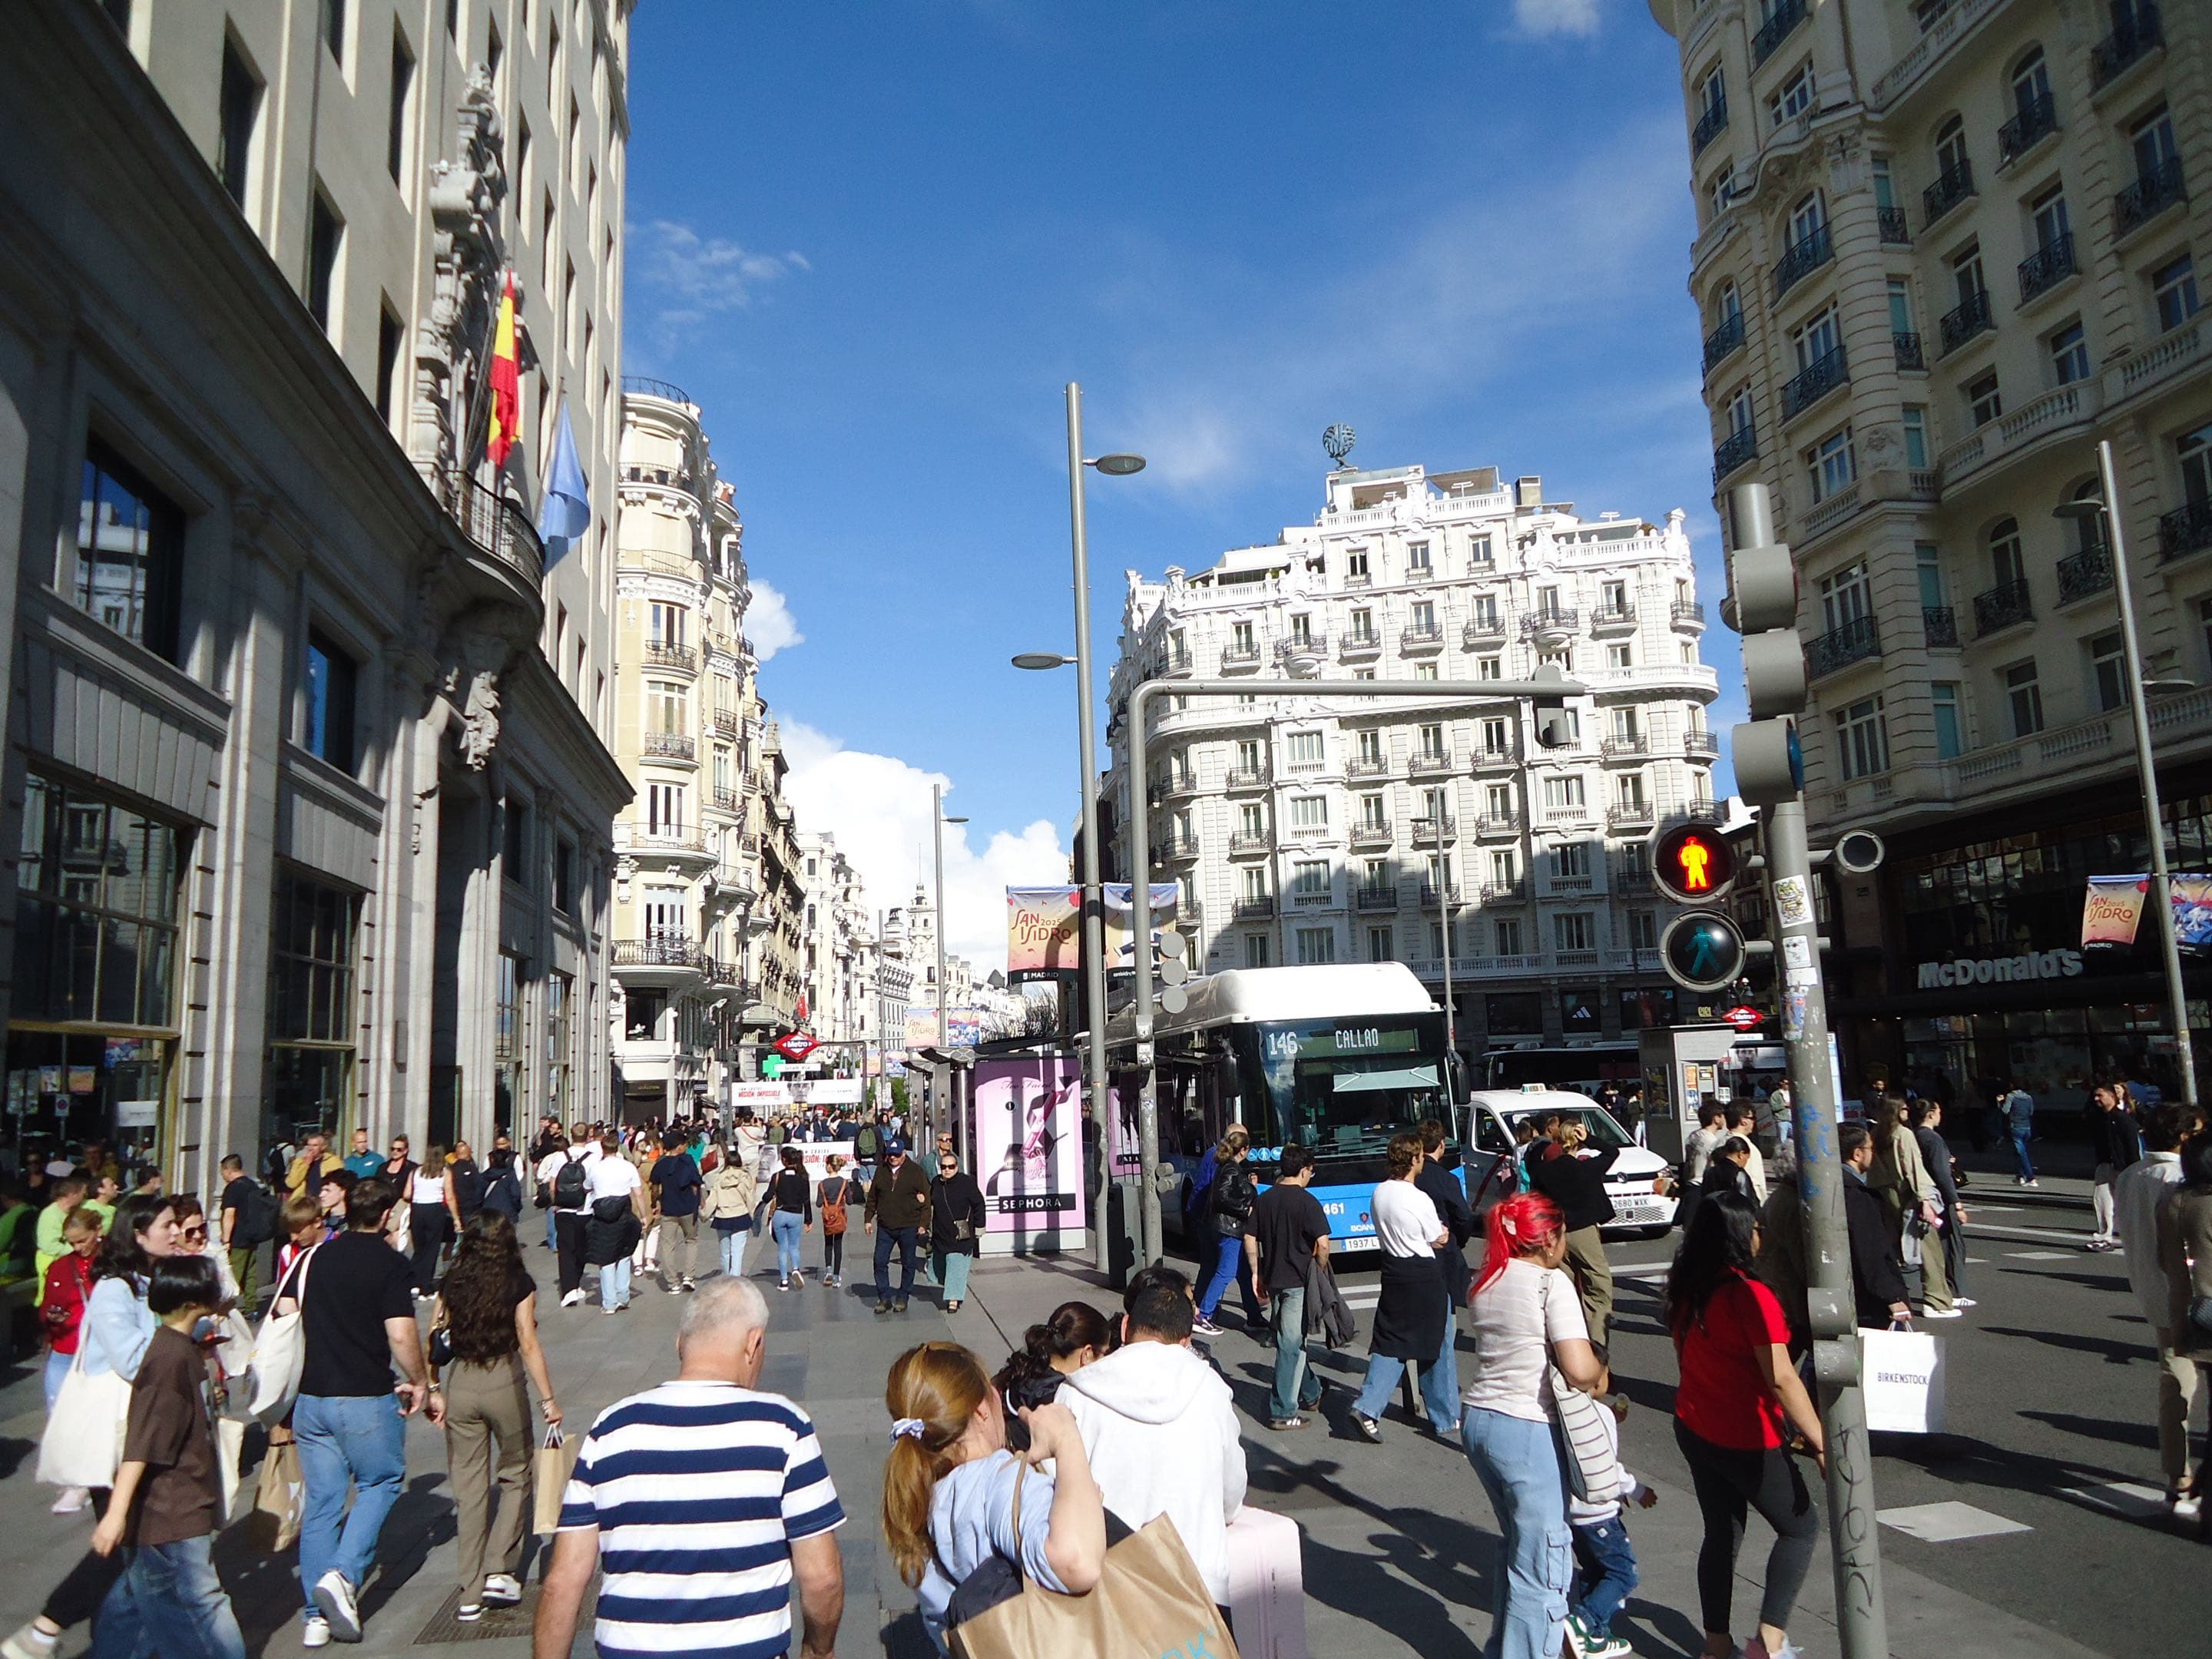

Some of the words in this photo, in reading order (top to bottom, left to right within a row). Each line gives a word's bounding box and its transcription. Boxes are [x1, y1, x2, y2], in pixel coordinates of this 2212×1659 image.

[1012, 909, 1040, 930] SAN
[1021, 925, 1071, 944] ISIDRO
[1918, 948, 2083, 988] McDonald's
[1269, 1031, 1298, 1055] 146
[1335, 1028, 1379, 1049] CALLAO
[1002, 1196, 1061, 1210] SEPHORA
[1349, 1239, 1368, 1248] 1937
[1877, 1372, 1929, 1386] BIRKENSTOCK
